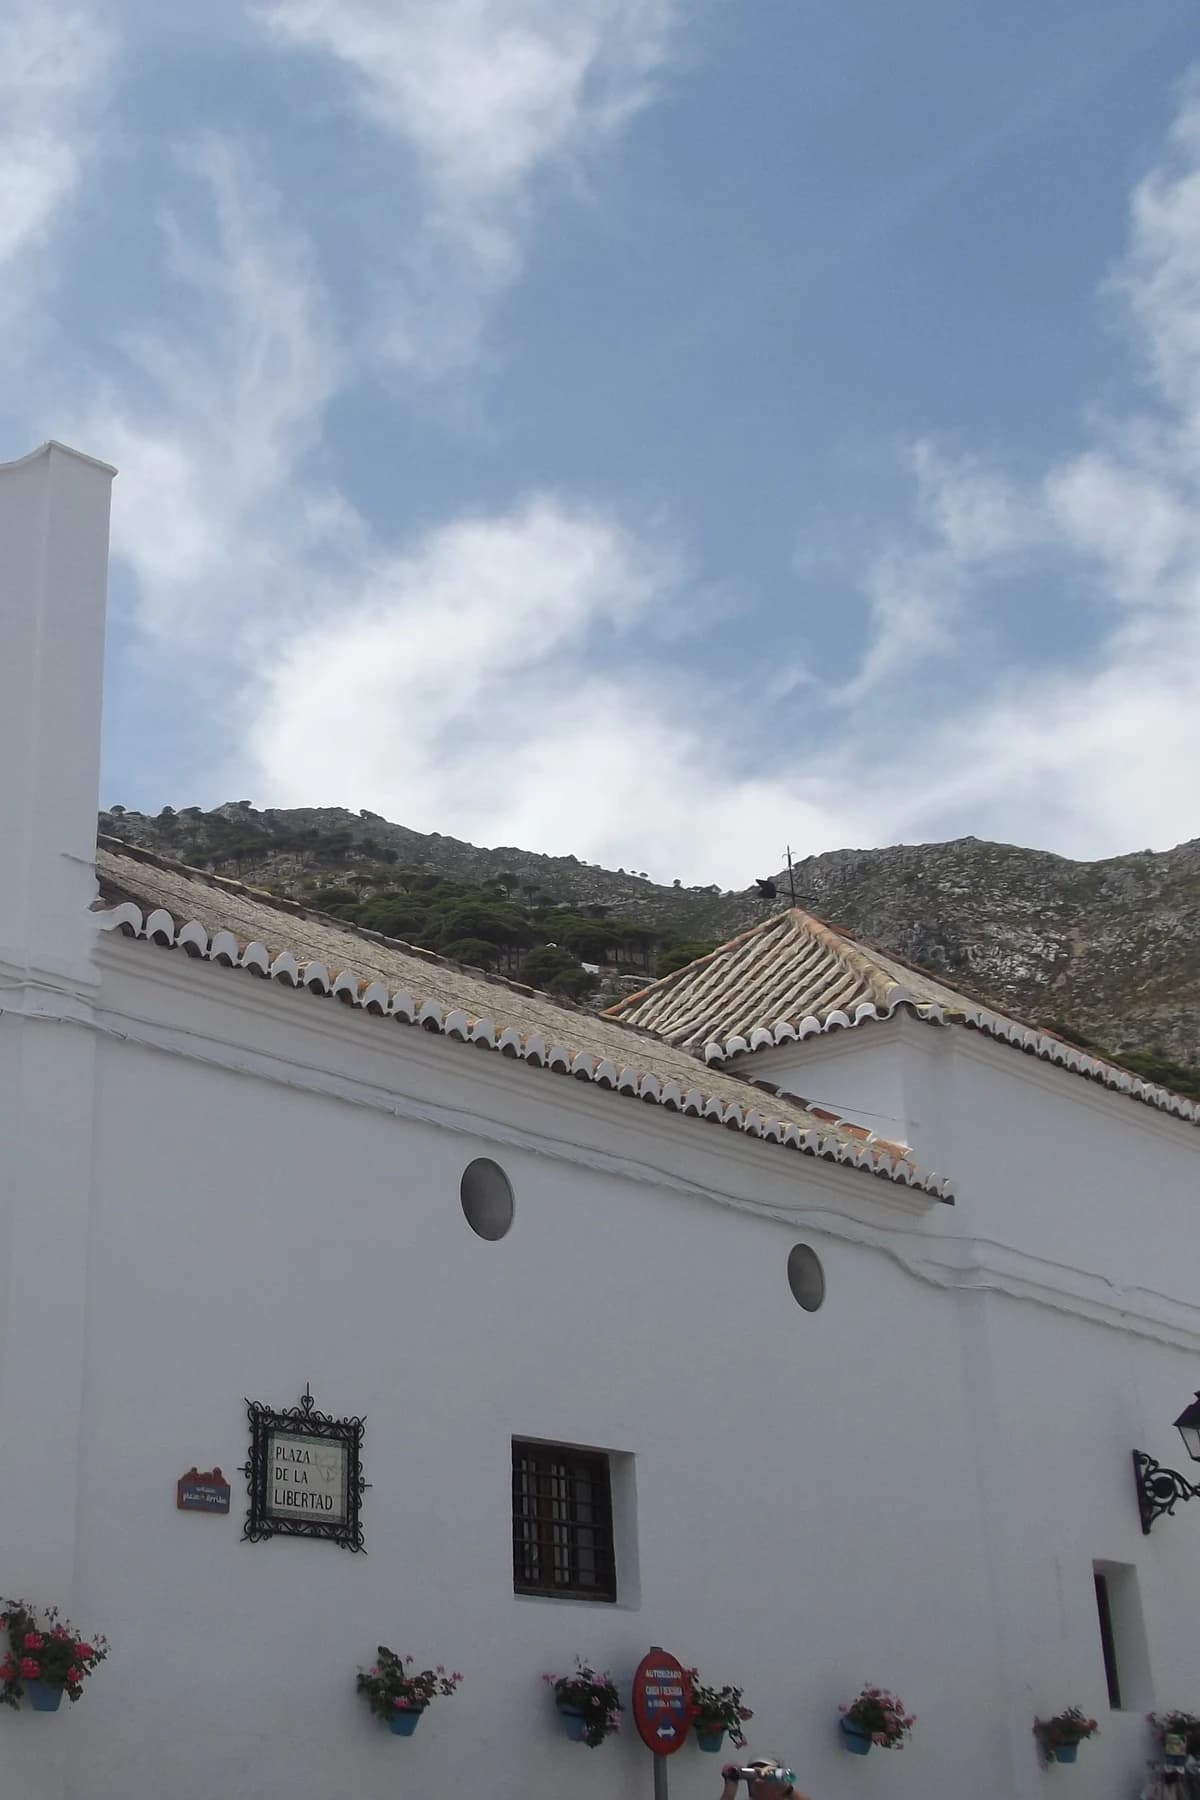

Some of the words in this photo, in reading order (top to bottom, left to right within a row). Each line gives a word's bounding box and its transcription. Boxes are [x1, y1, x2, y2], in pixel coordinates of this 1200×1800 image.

[276, 1446, 310, 1464] PLAZA
[275, 1467, 289, 1481] DE
[294, 1469, 308, 1484] LA
[274, 1488, 333, 1510] LIBERTAD
